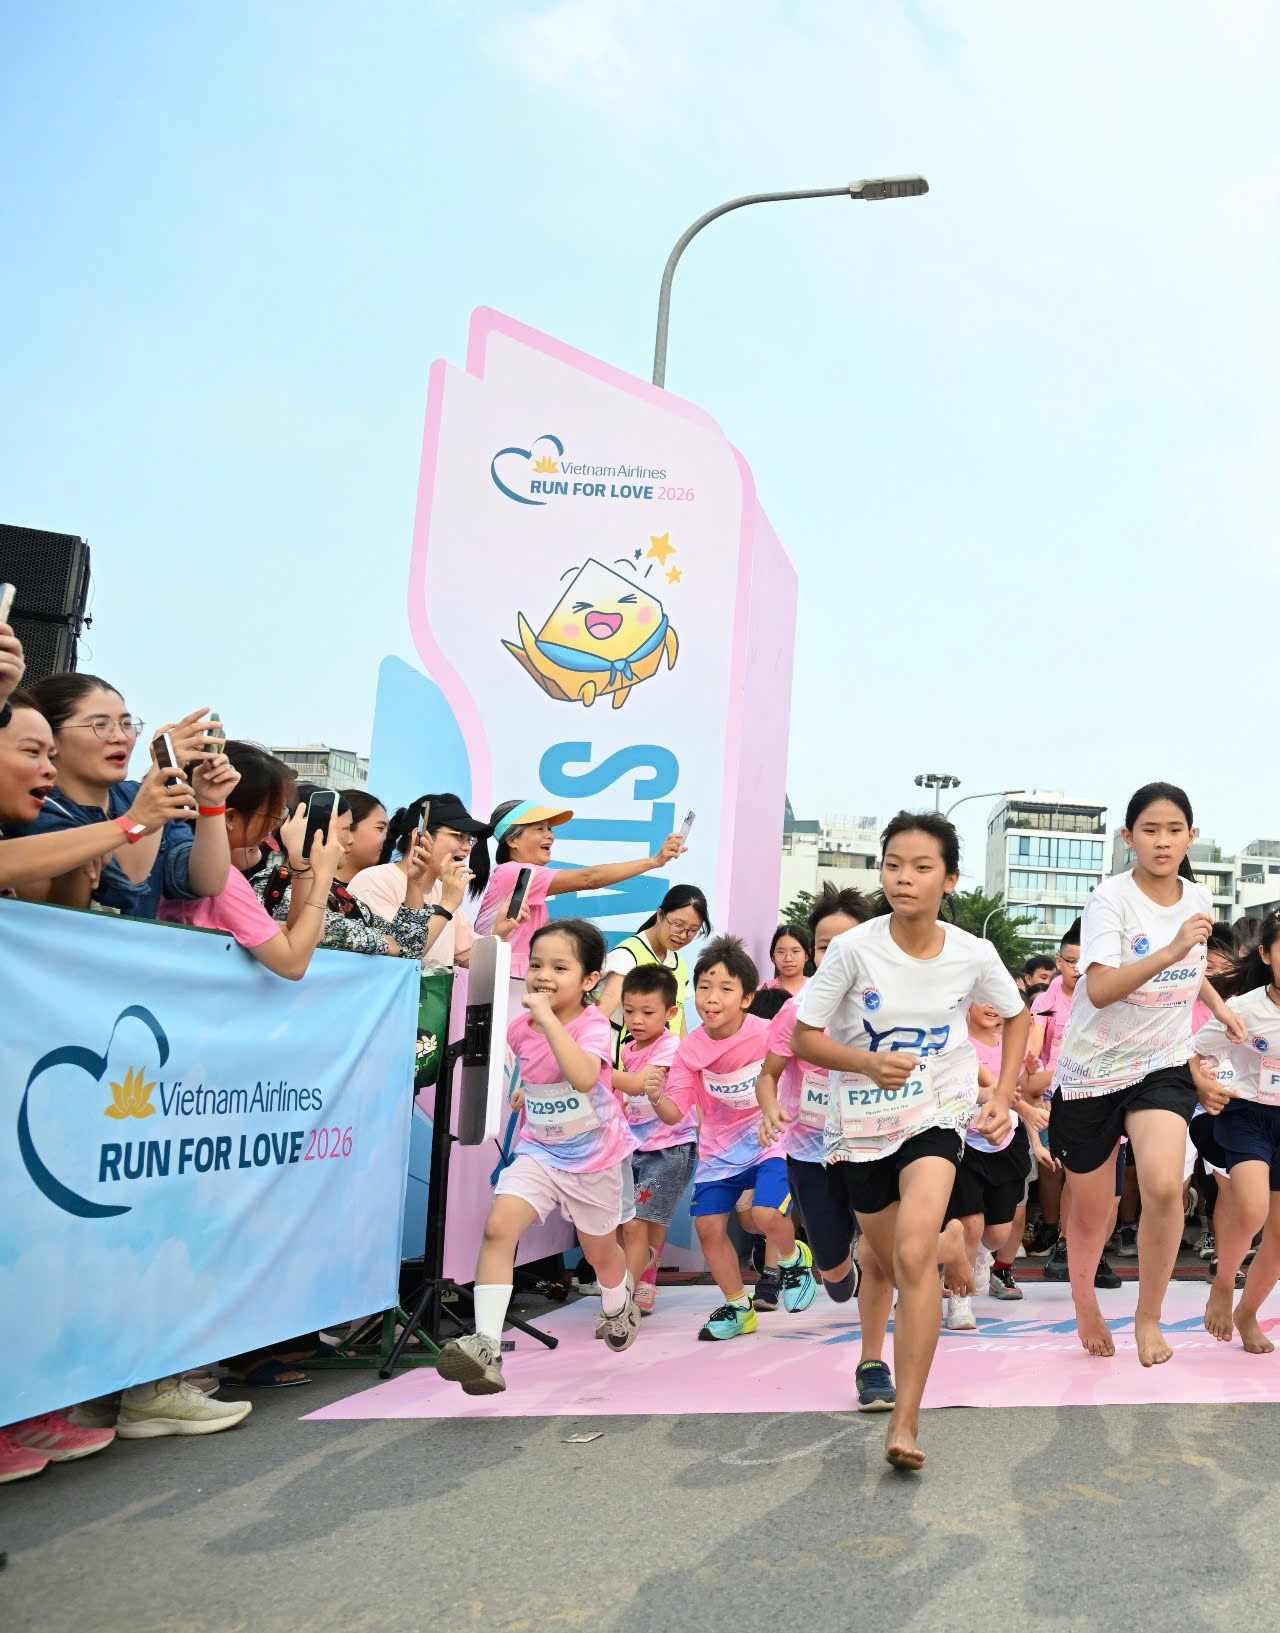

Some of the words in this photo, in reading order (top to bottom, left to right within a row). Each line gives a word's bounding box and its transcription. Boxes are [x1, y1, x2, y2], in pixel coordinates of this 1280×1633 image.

[560, 460, 617, 478] Vietnam
[618, 463, 667, 481] Airlines
[530, 479, 568, 496] RUN
[572, 481, 607, 498] FOR
[610, 483, 654, 500] LOVE
[657, 485, 695, 502] 2026
[1152, 968, 1198, 983] 22684
[709, 1076, 757, 1094] M2237
[160, 1080, 249, 1116] Vietnam
[250, 1080, 322, 1114] Airlines
[98, 1138, 172, 1183] RUN
[178, 1134, 232, 1175] FOR
[238, 1130, 304, 1169] LOVE
[303, 1125, 354, 1161] 2026
